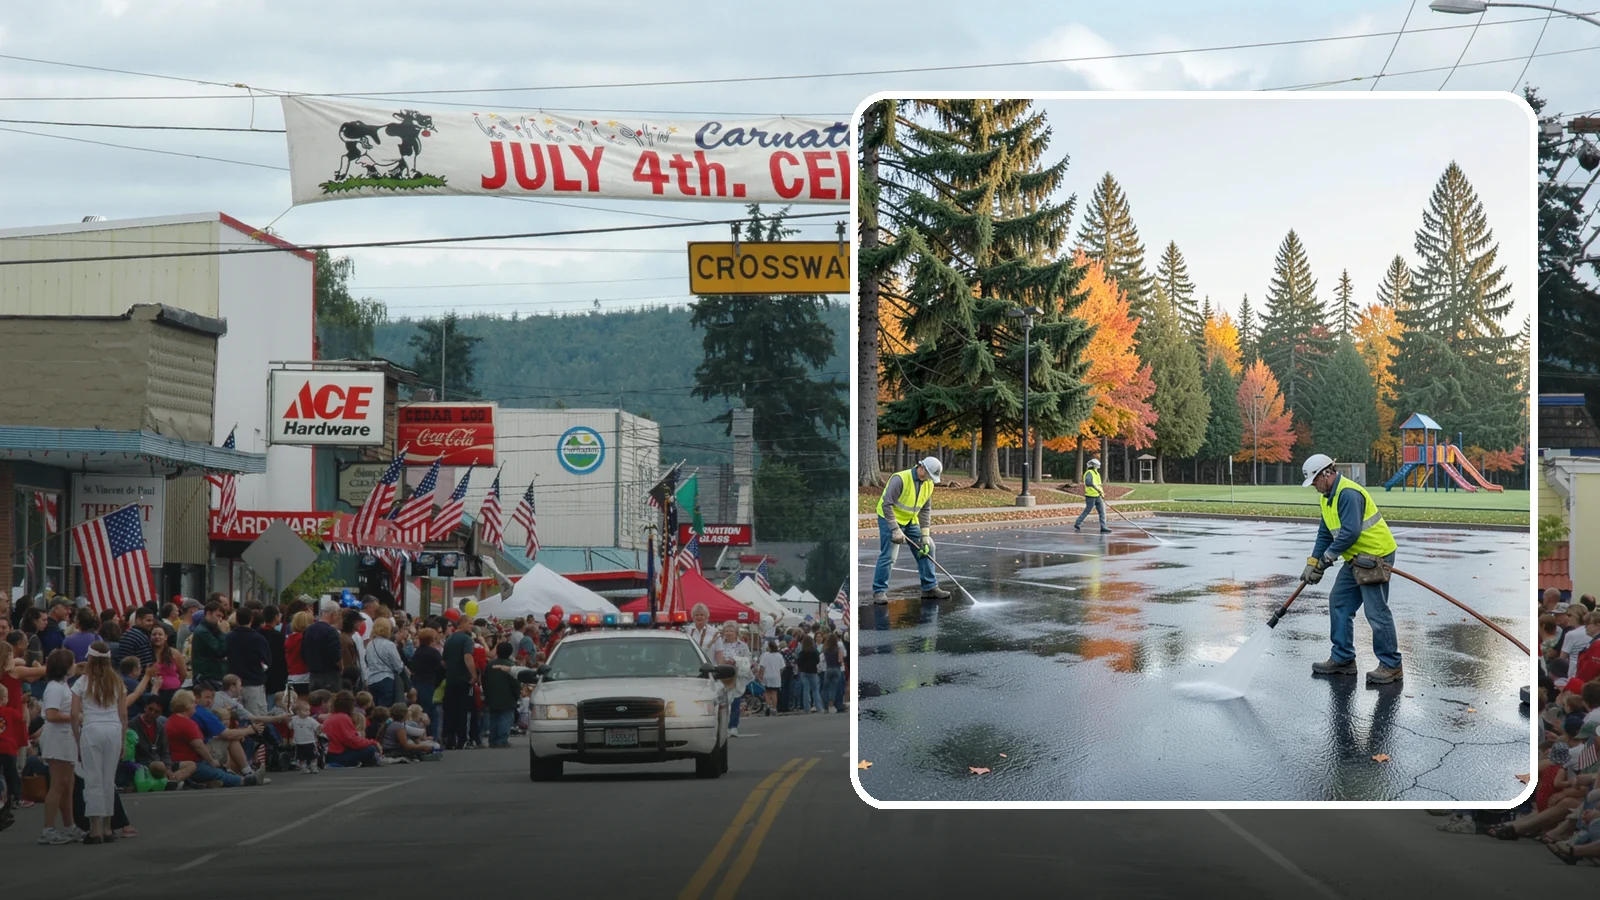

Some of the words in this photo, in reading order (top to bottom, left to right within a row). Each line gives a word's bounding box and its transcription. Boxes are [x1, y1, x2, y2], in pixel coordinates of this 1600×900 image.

[481, 141, 604, 192] JULY
[632, 151, 746, 198] 4th.
[697, 254, 850, 280] CROSSWA
[283, 380, 373, 420] ACE
[406, 409, 452, 421] CEDAR
[284, 421, 370, 436] Hardware
[416, 428, 477, 447] Coca-Cola
[354, 467, 385, 480] Simpl
[83, 485, 93, 494] St.
[95, 485, 124, 494] Vincent
[126, 486, 135, 494] de
[137, 486, 155, 495] Paul
[688, 526, 742, 535] CRNATION
[699, 535, 730, 543] GLASS
